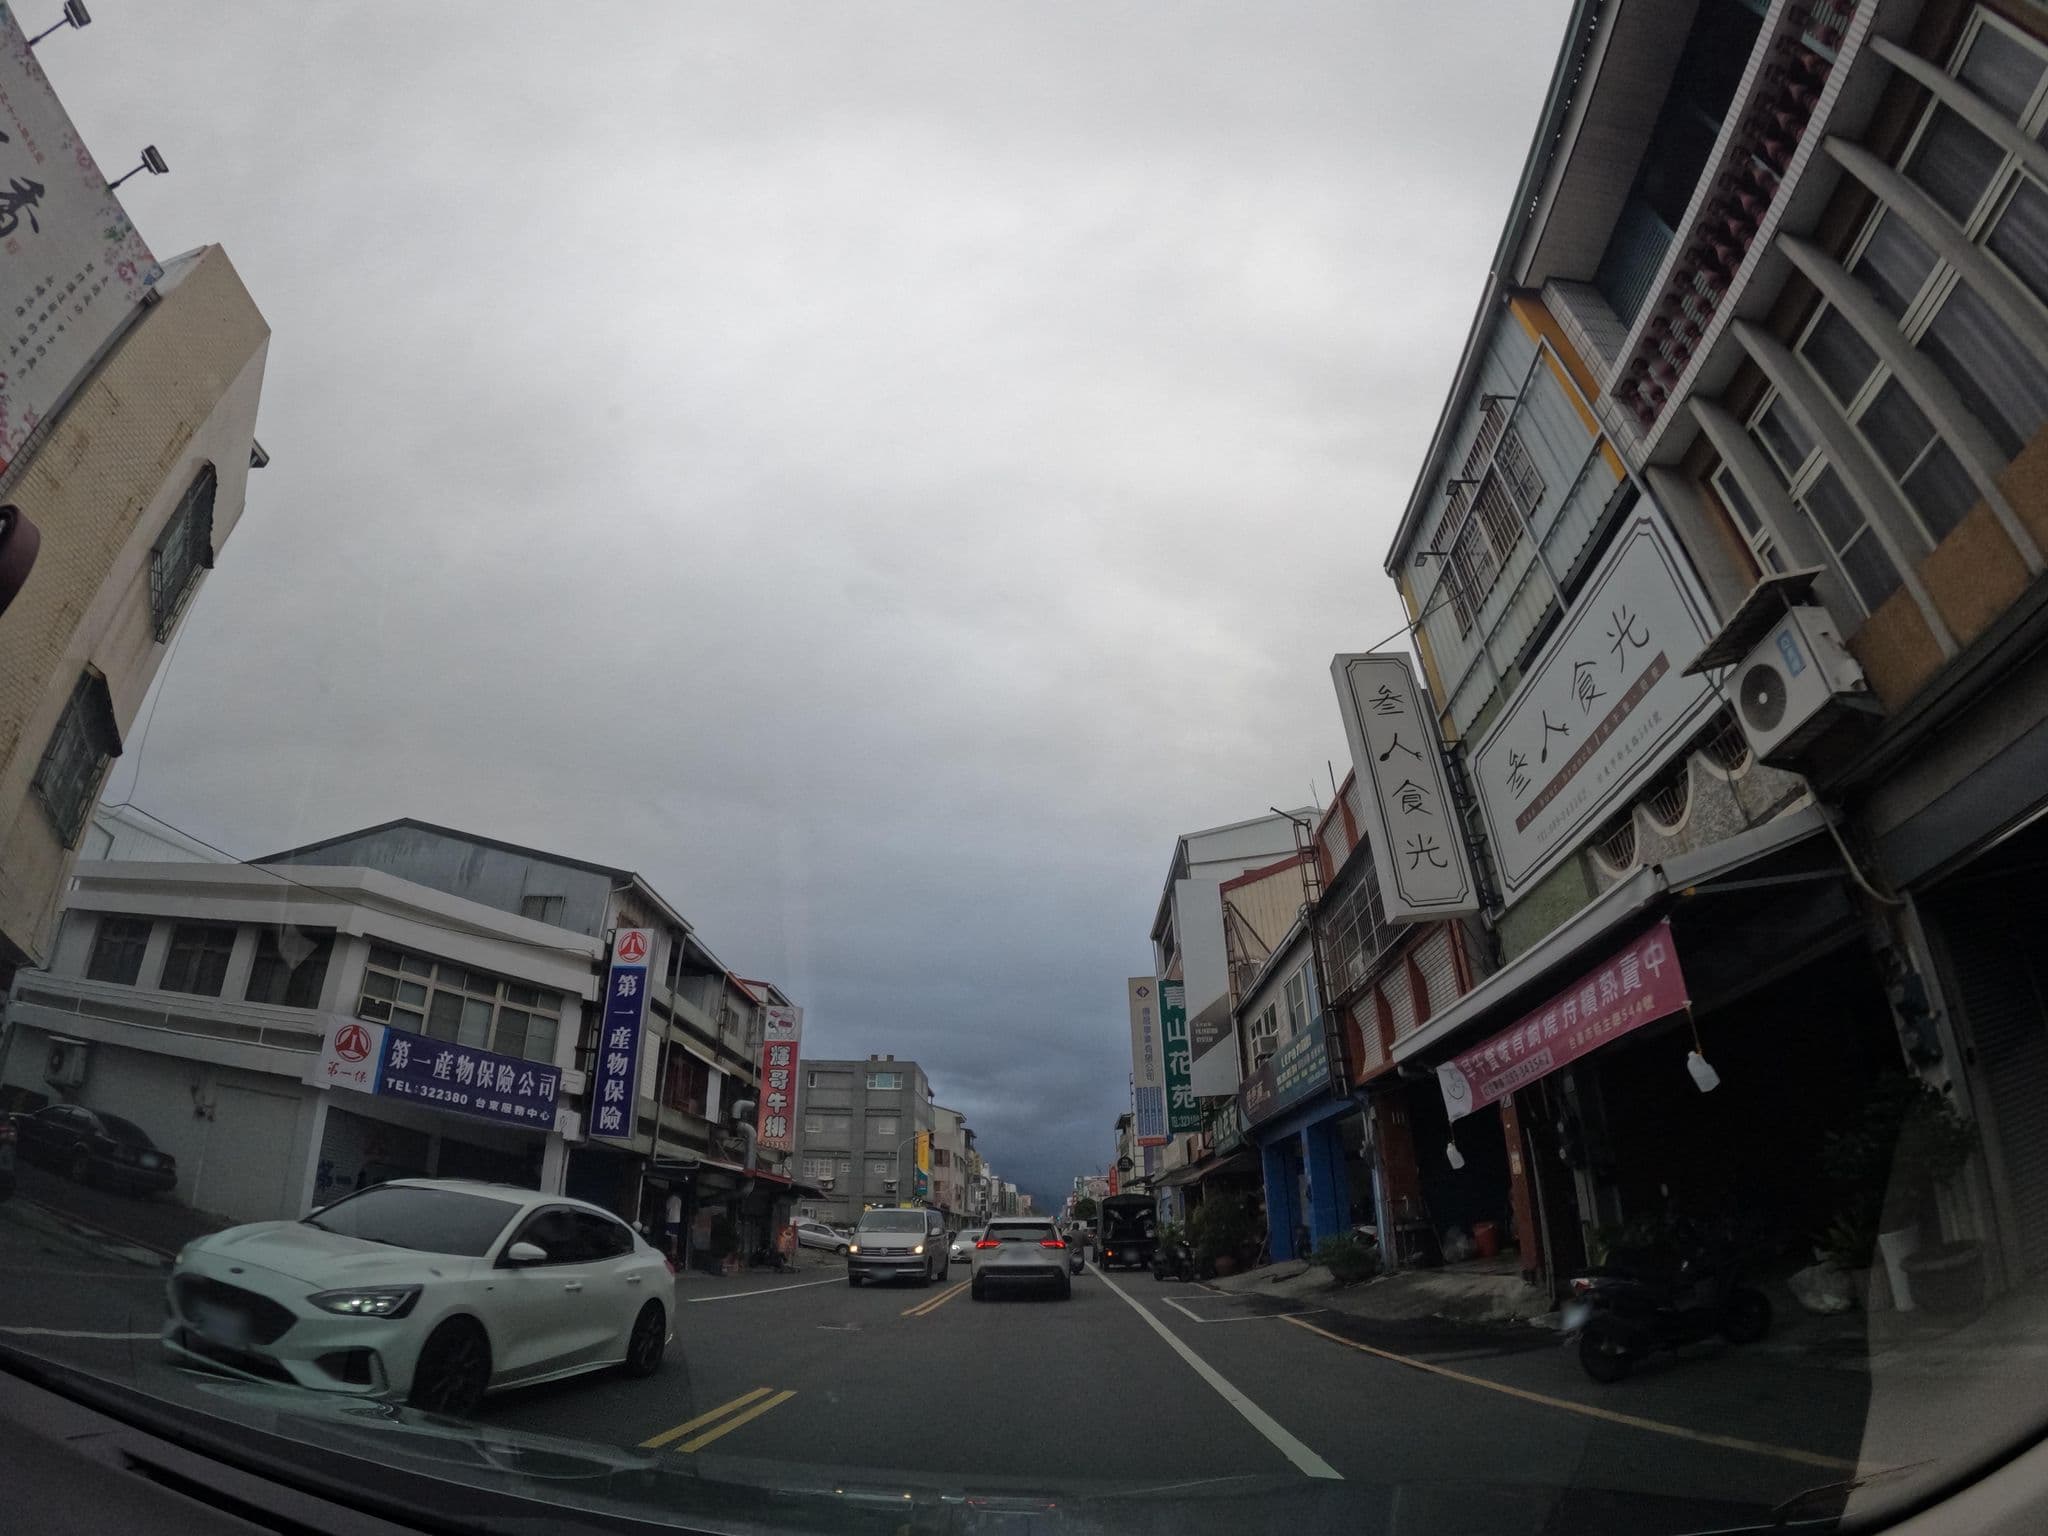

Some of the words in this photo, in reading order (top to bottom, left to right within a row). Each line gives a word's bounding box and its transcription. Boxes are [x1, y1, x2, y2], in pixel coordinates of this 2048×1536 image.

[386, 1078, 468, 1105] TEL:322380
[475, 1097, 551, 1121] 台東服務中心
[764, 1045, 791, 1138] 輝哥牛排
